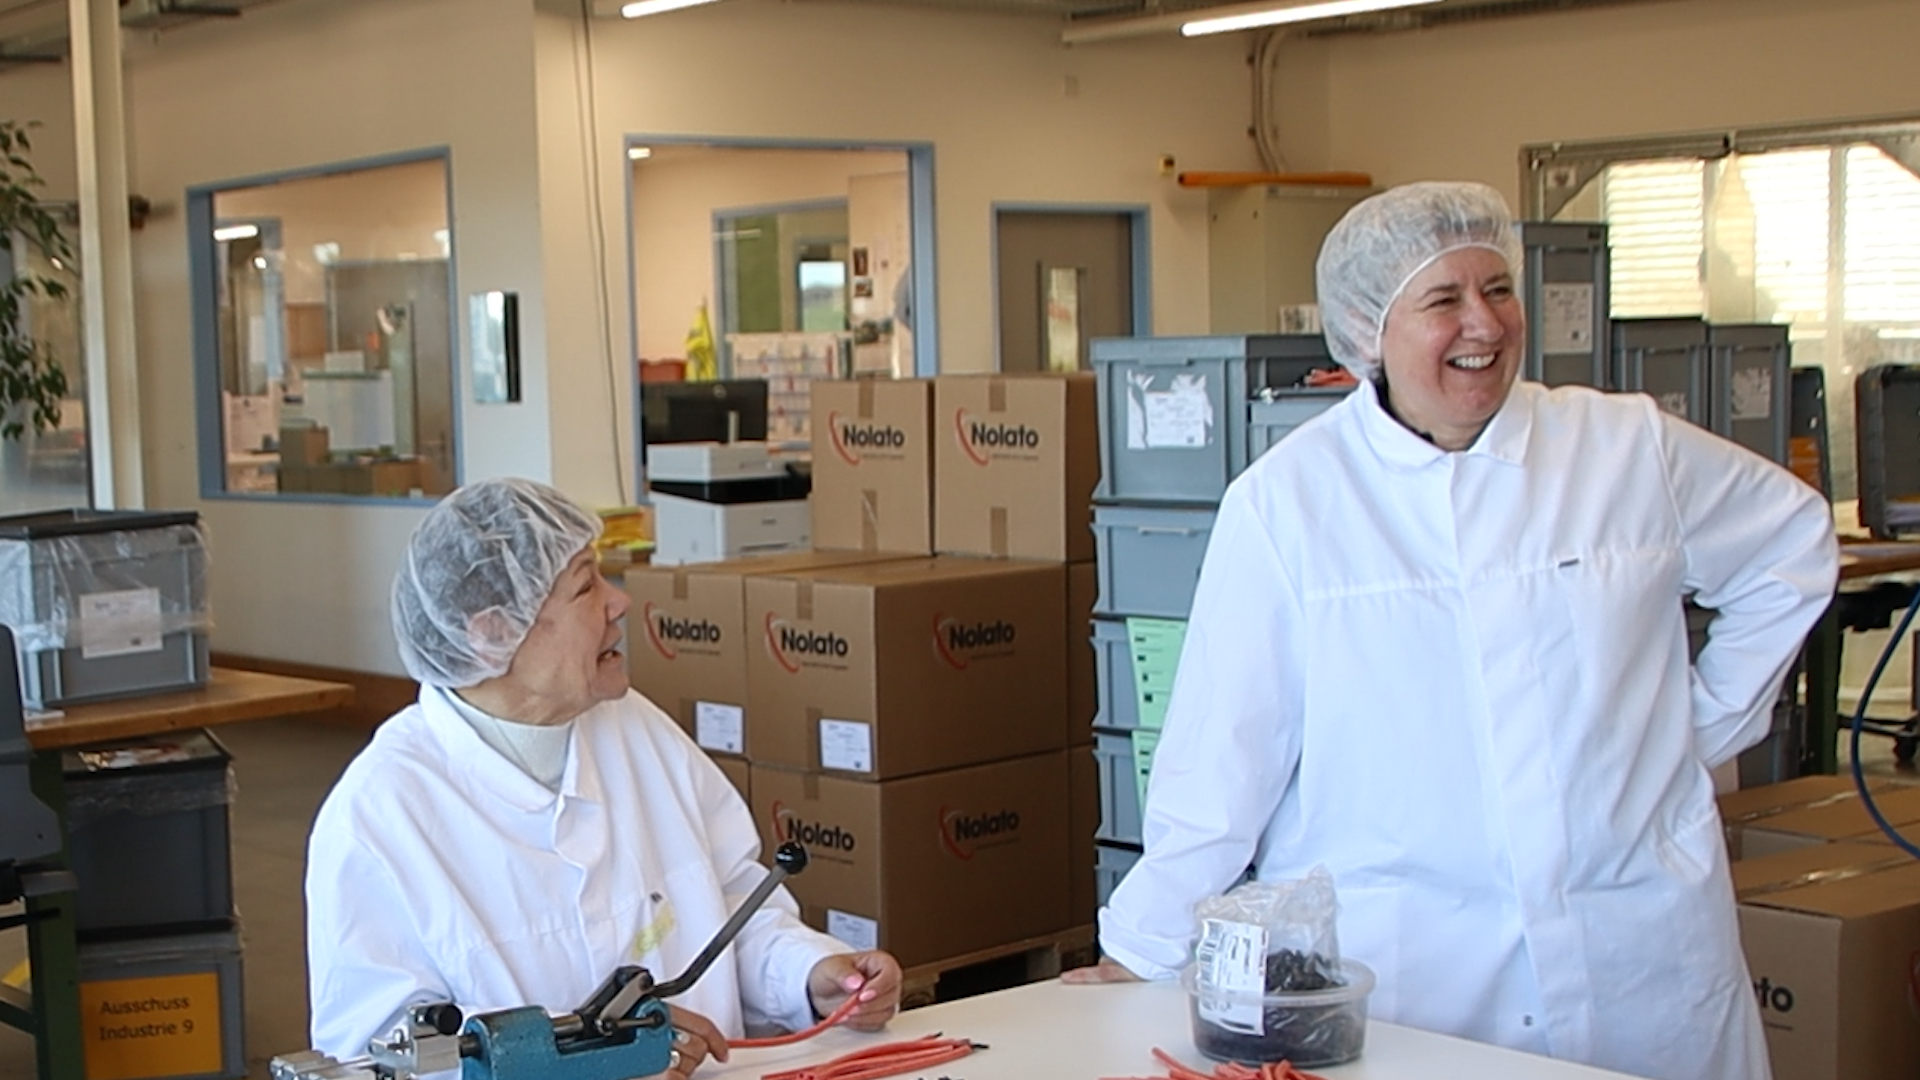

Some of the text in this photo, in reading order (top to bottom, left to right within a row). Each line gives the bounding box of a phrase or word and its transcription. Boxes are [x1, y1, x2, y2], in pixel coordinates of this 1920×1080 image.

[842, 424, 904, 449] Nolato
[971, 422, 1039, 448] Nolato
[659, 617, 721, 643] Nolato
[781, 626, 848, 657] Nolato
[949, 619, 1016, 651] Nolato
[788, 817, 855, 851] Nolato
[955, 808, 1020, 842] Nolato
[101, 997, 190, 1015] Ausschuss
[100, 1019, 194, 1040] Industrie 9
